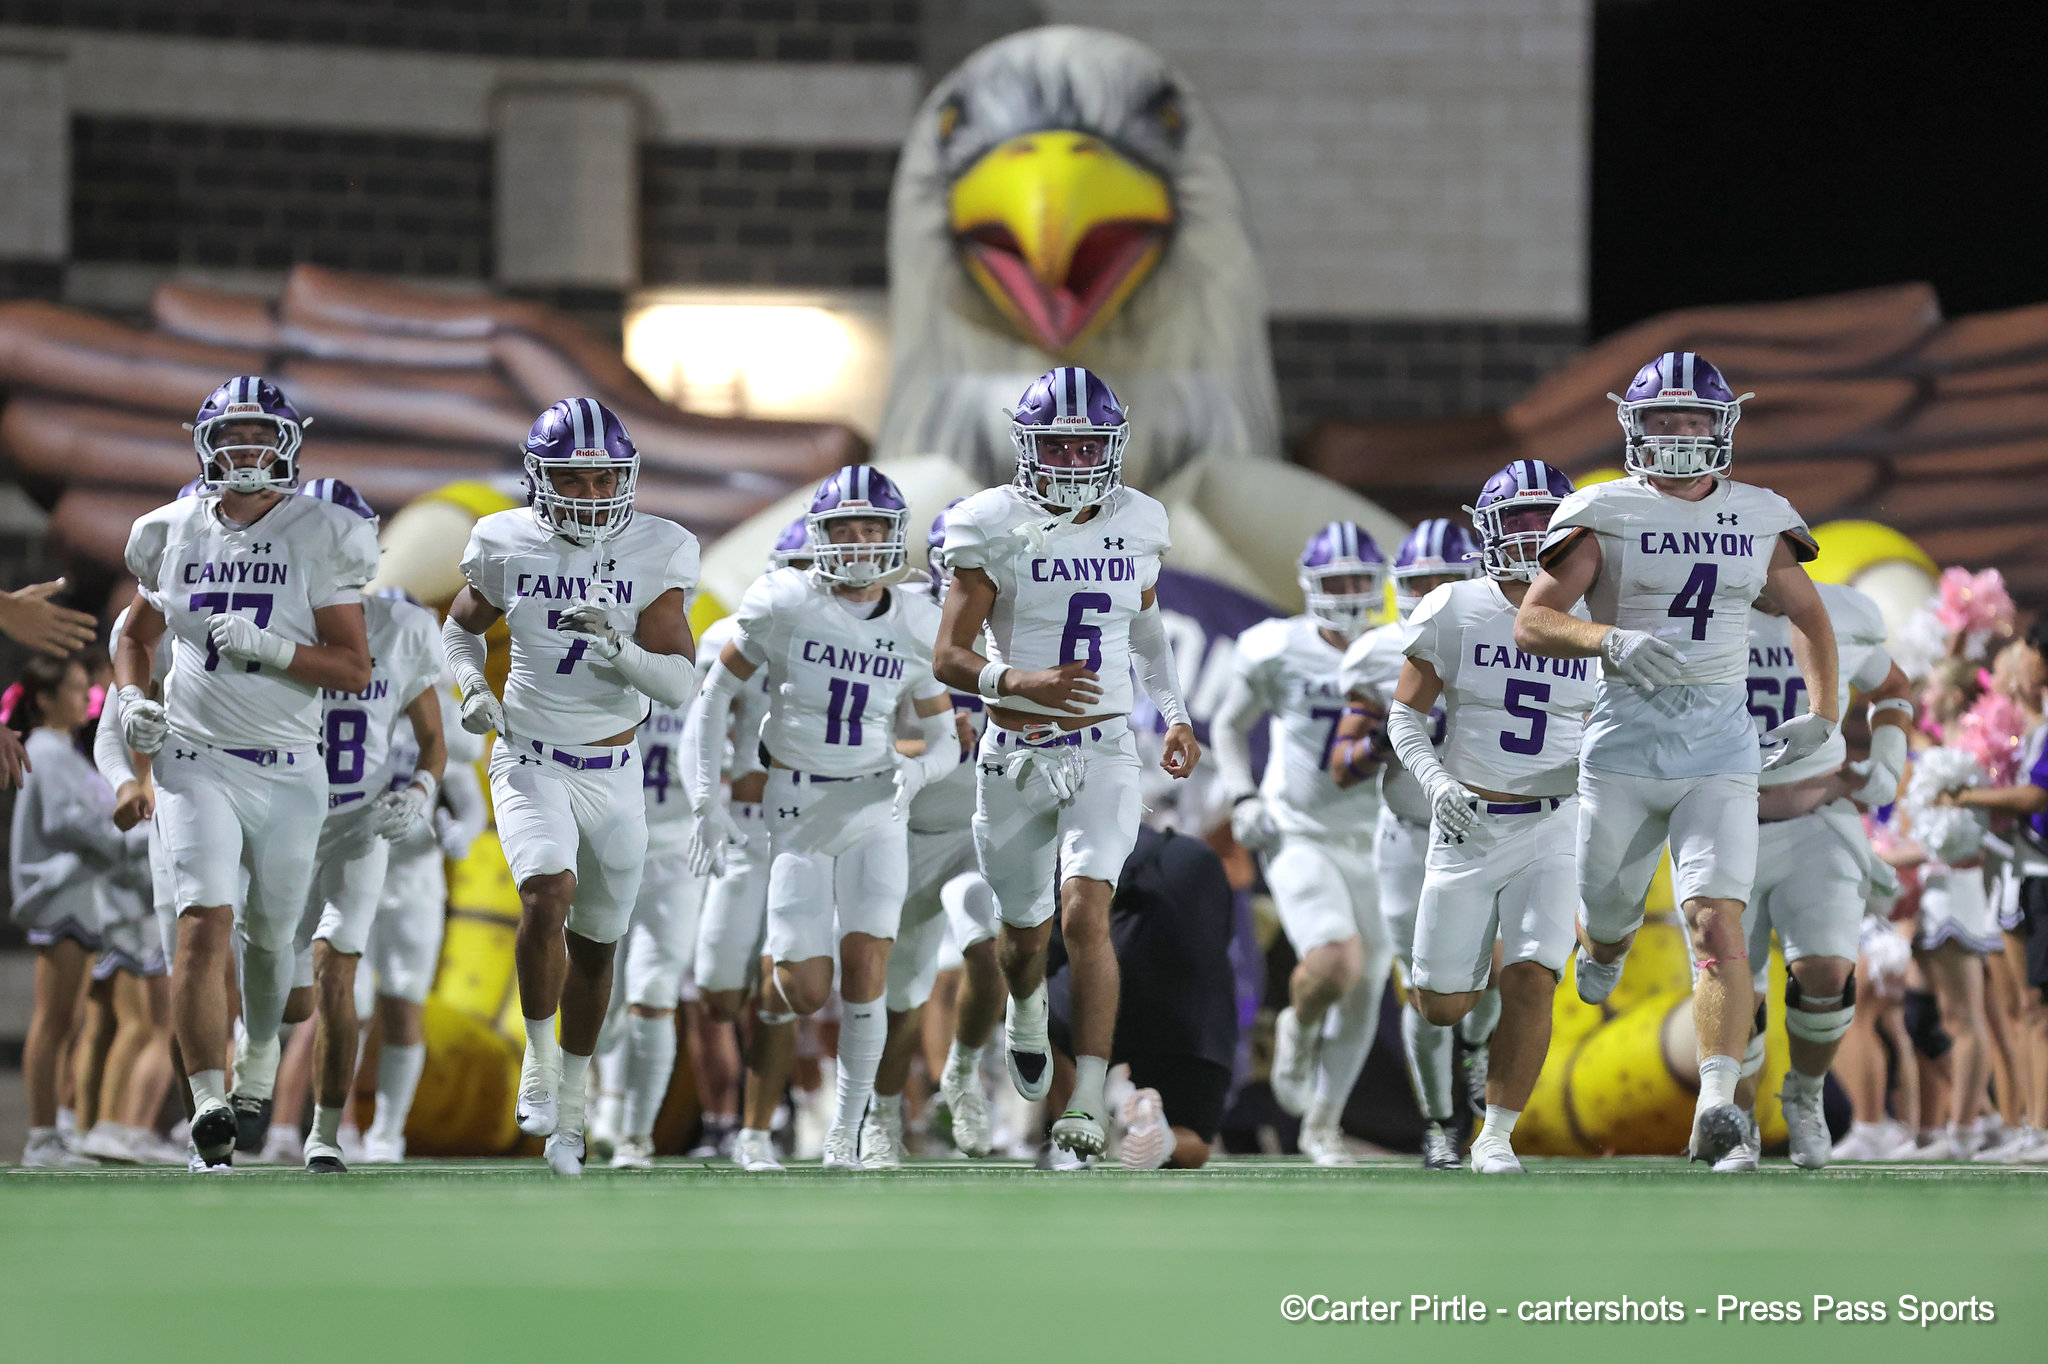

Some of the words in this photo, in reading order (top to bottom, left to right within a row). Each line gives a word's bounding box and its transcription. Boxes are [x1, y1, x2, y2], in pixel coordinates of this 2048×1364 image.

[1032, 557, 1136, 582] CANYON
[1641, 532, 1754, 557] CANYON
[184, 561, 287, 585] CANYON
[1668, 563, 1718, 641] 4
[189, 592, 274, 672] 77
[803, 639, 905, 680] CANYON
[1059, 592, 1112, 675] 6
[1474, 643, 1587, 681] CANYON
[825, 677, 870, 746] 11
[1500, 678, 1551, 755] 5
